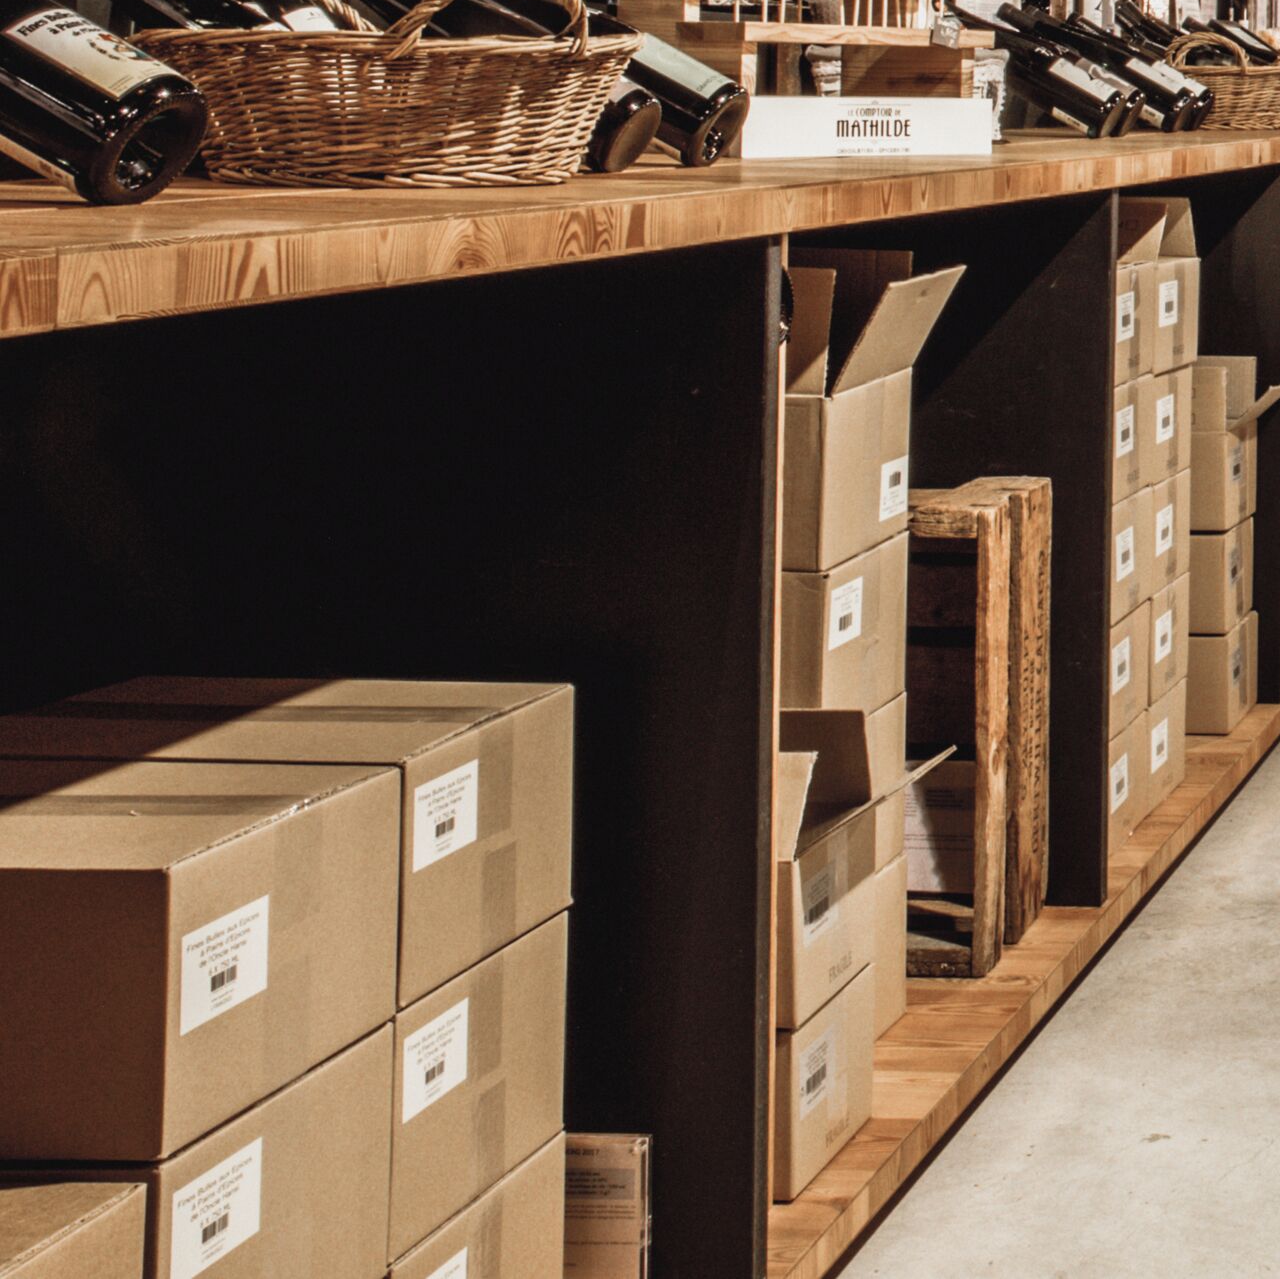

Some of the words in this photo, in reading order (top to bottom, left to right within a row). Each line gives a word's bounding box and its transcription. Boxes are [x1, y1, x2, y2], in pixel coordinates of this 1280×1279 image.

[16, 18, 49, 37] Fines
[855, 107, 893, 117] COMPTOIR
[836, 118, 911, 138] MATHILDE
